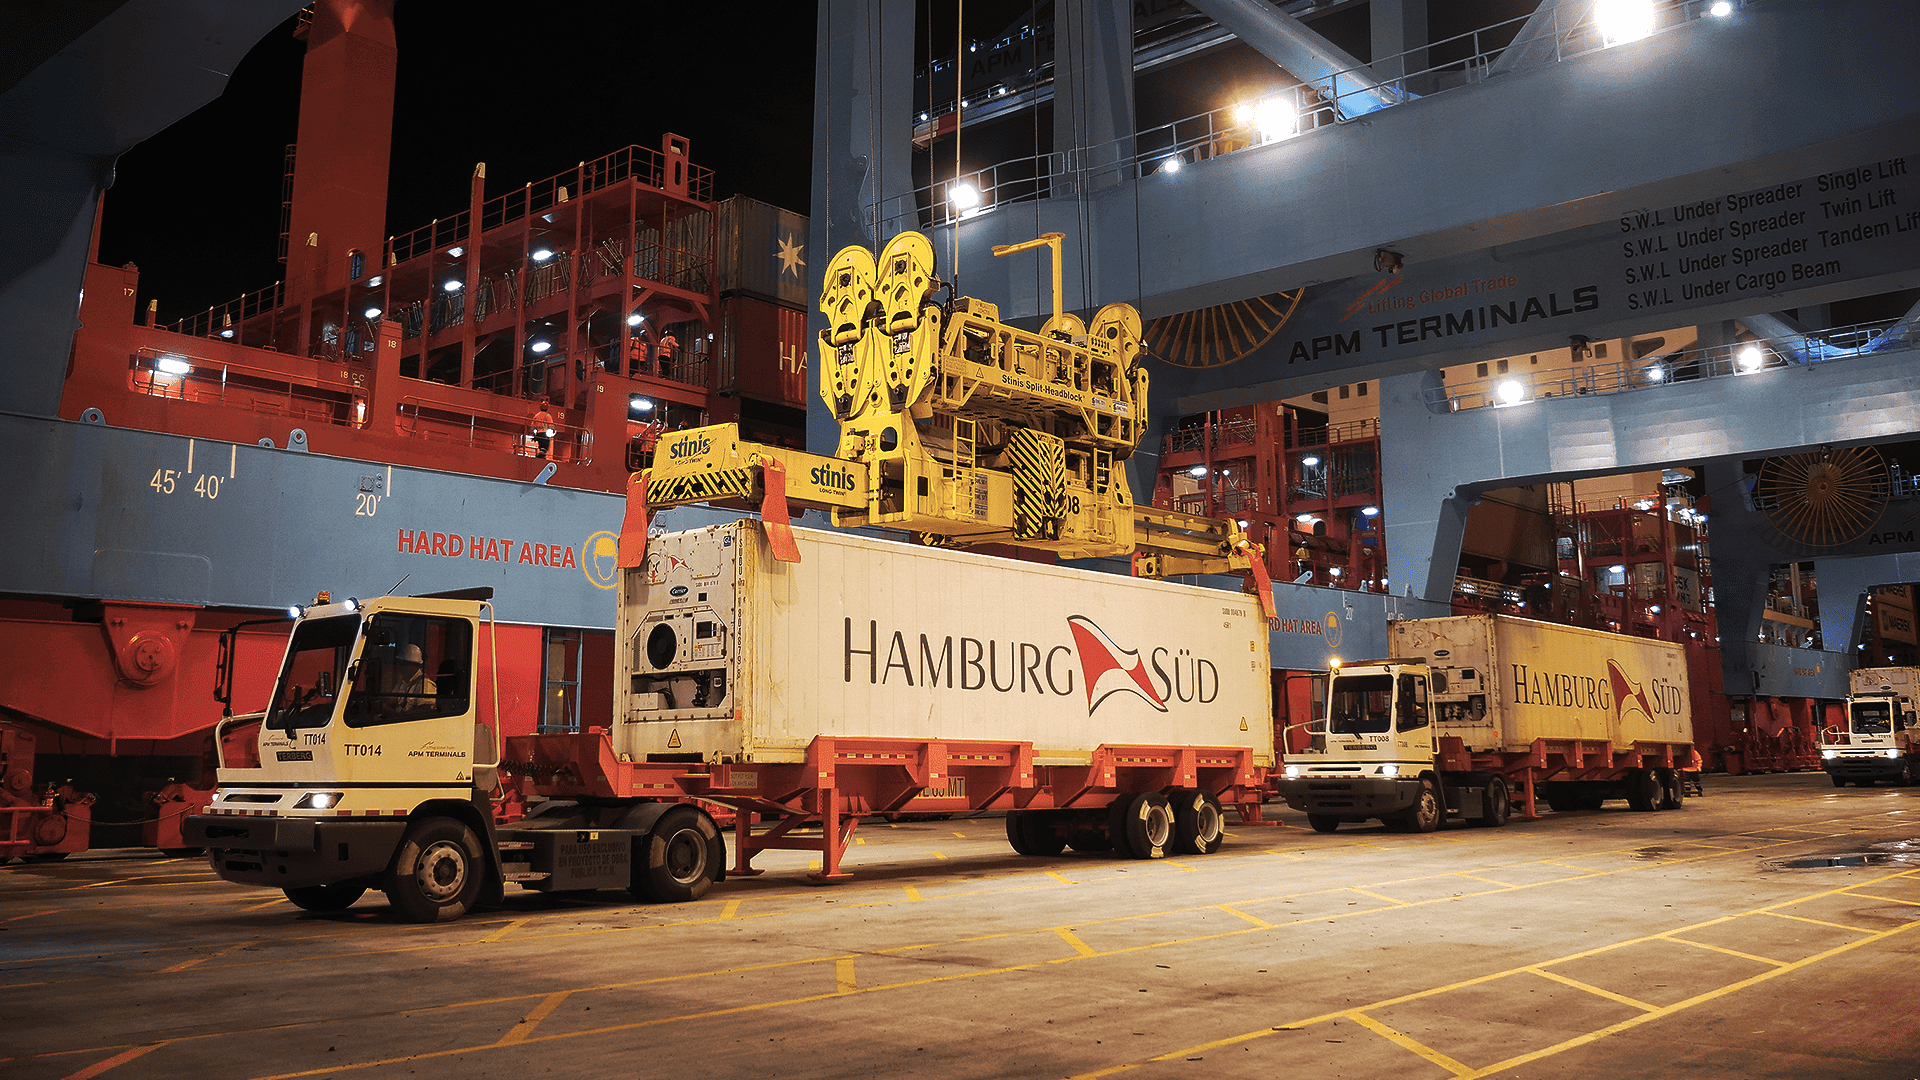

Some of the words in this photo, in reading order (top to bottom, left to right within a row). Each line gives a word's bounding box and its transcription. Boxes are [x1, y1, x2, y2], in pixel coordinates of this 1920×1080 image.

[970, 51, 1023, 80] APM
[1620, 213, 1665, 233] S.W.L
[1674, 200, 1722, 222] Under
[1726, 183, 1803, 213] Spreader
[1817, 166, 1873, 193] Single
[1878, 157, 1907, 180] Lift
[1623, 235, 1668, 258] S.W.L
[1677, 226, 1724, 248] Under
[1729, 209, 1806, 240] Spreader
[1820, 195, 1862, 219] Twin
[1867, 188, 1897, 210] Lift
[1625, 260, 1671, 284] S.W.L
[1679, 252, 1727, 274] Under
[1732, 236, 1808, 266] Spreader
[1818, 220, 1890, 248] Tandem
[123, 288, 134, 297] 17
[1368, 293, 1415, 315] Lifting
[1420, 284, 1468, 304] Global
[1474, 274, 1518, 293] Trade
[1628, 287, 1673, 310] S.W.L
[1682, 278, 1730, 301] Under
[1736, 267, 1786, 291] Cargo
[1792, 259, 1841, 281] Beam
[1288, 329, 1361, 365] APM
[1372, 285, 1599, 348] TERMINALS
[388, 340, 397, 348] 18
[340, 370, 349, 379] 18
[597, 385, 604, 393] 19
[1002, 374, 1024, 389] Stinis
[1025, 380, 1084, 403] Split-Headblock
[557, 412, 565, 420] 19
[669, 433, 711, 461] stinis
[810, 463, 856, 492] stinis
[398, 528, 464, 557] HARD
[469, 535, 514, 563] HAT
[518, 542, 577, 569] AREA
[1868, 531, 1914, 546] APM
[1268, 616, 1281, 632] RD
[1282, 618, 1299, 634] HAT
[1301, 620, 1323, 636] AREA
[843, 616, 1074, 697] HAMBURG
[1150, 646, 1221, 704] SÜD
[1511, 664, 1610, 711] HAMBURG
[1652, 678, 1682, 715] SÜD
[304, 733, 326, 746] TT014
[344, 743, 382, 757] TT014
[277, 751, 312, 761] TERBERG
